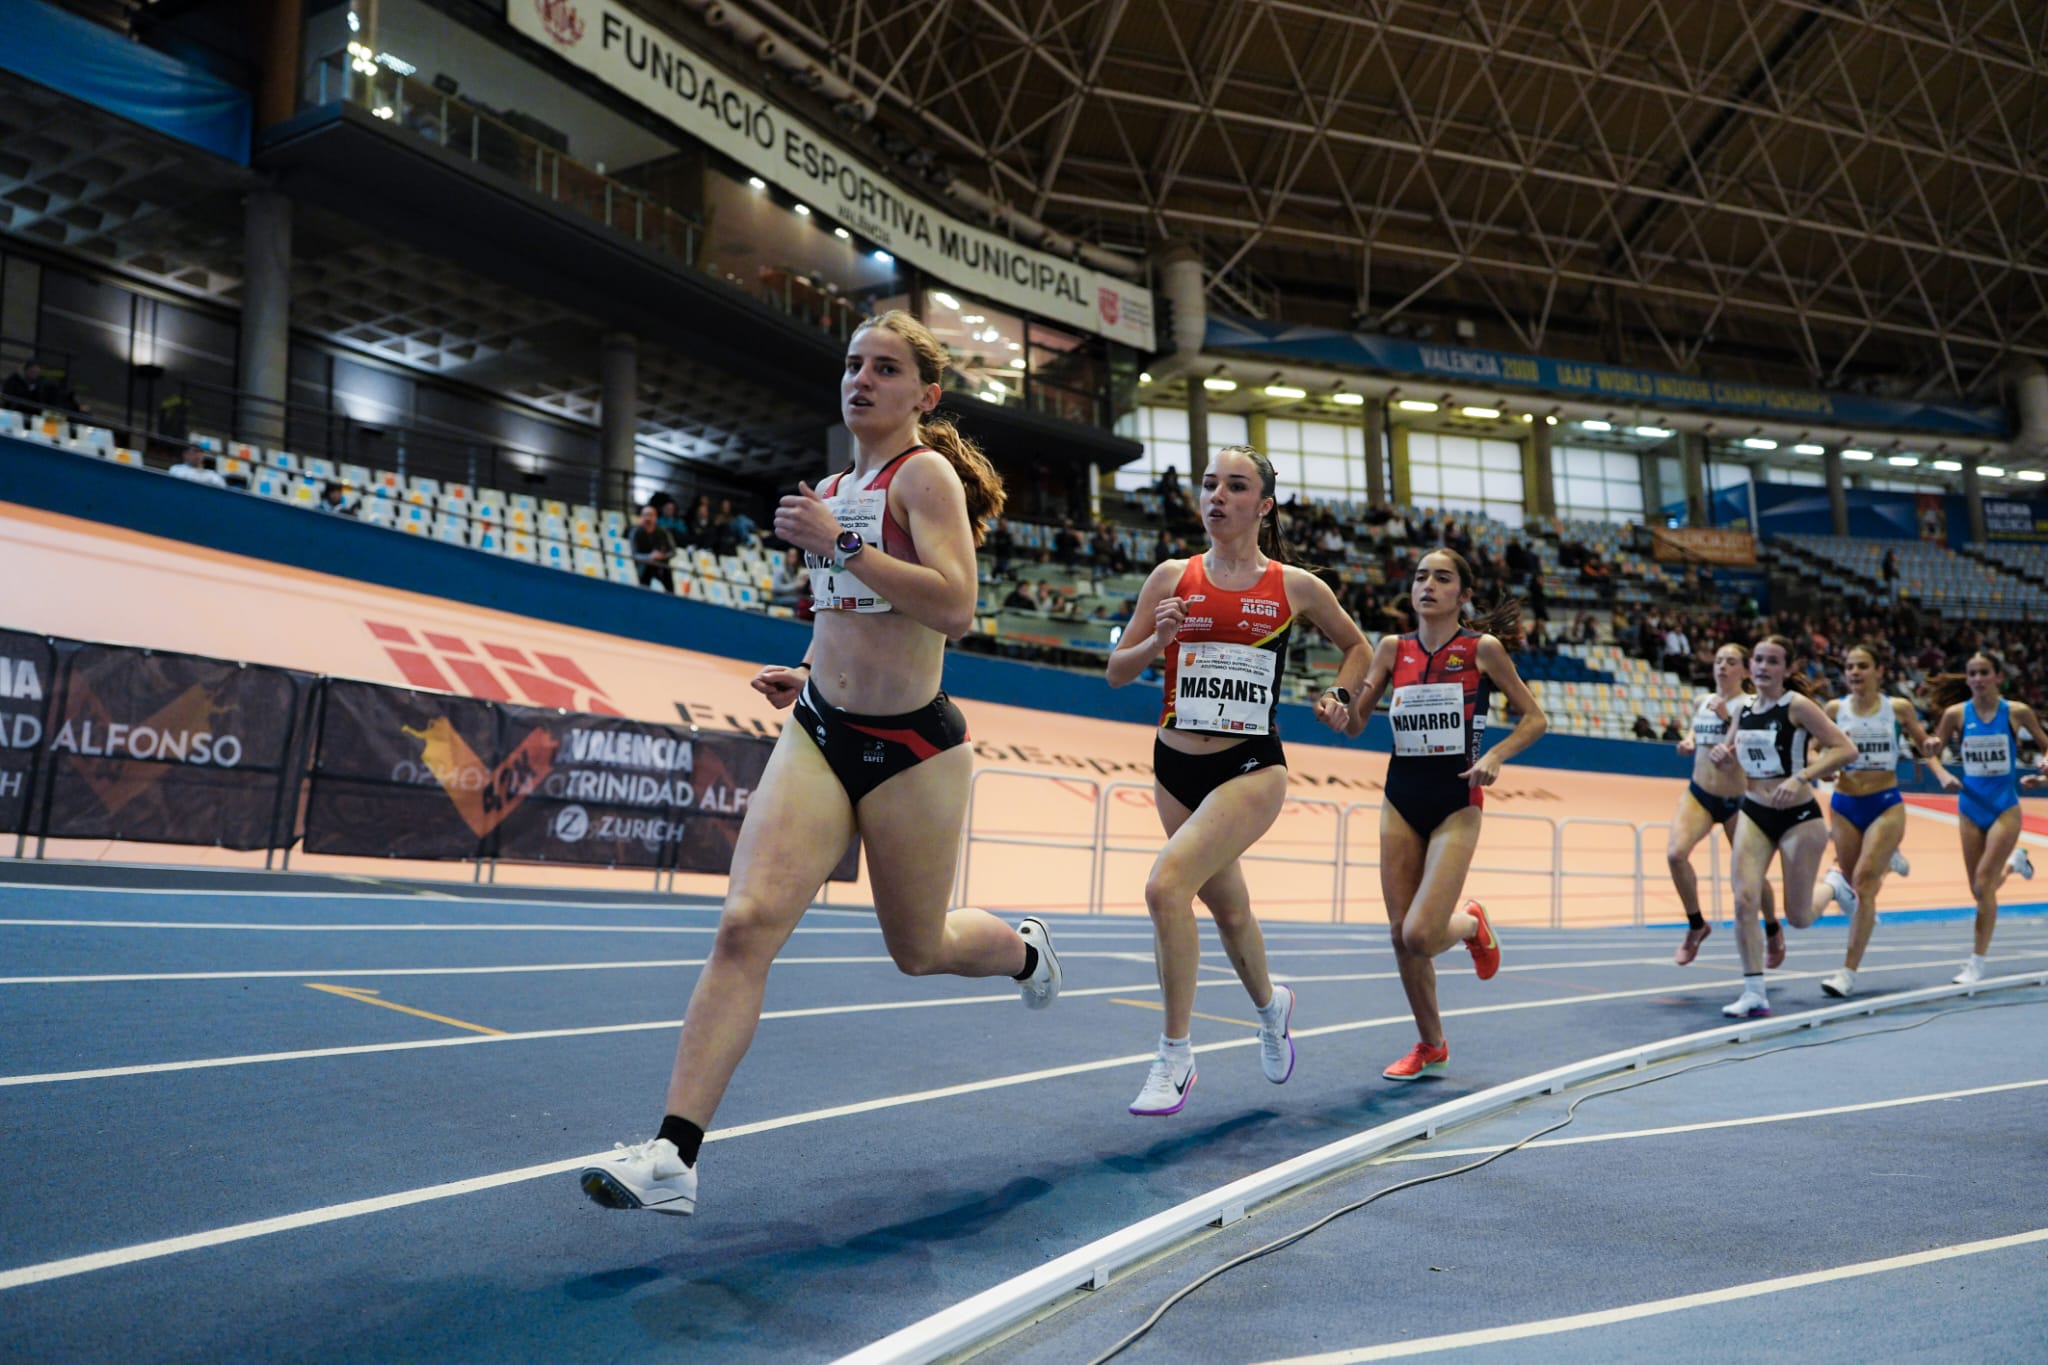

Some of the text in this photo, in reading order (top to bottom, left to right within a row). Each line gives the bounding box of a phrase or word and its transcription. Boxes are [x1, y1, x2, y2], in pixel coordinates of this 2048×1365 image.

[602, 11, 1090, 308] FUNDACIÓ ESPORTIVA MUNICIPAL
[1418, 345, 1500, 377] VALENCIA
[1594, 368, 1653, 397] WORLD
[1654, 375, 1711, 402] INDOOR
[1713, 382, 1835, 416] CHAMPIONSHIPS
[828, 575, 835, 594] 4
[1241, 603, 1278, 618] ALCOI
[1180, 677, 1269, 705] MASANET
[1217, 703, 1225, 717] 7
[1392, 711, 1461, 732] NAVARRO
[50, 719, 243, 768] ALFONSO
[571, 728, 694, 773] VALENCIA
[1422, 733, 1428, 745] 1
[1965, 750, 2007, 763] PALLAS
[566, 770, 695, 808] TRINIDAD
[599, 816, 685, 843] ZURICH
